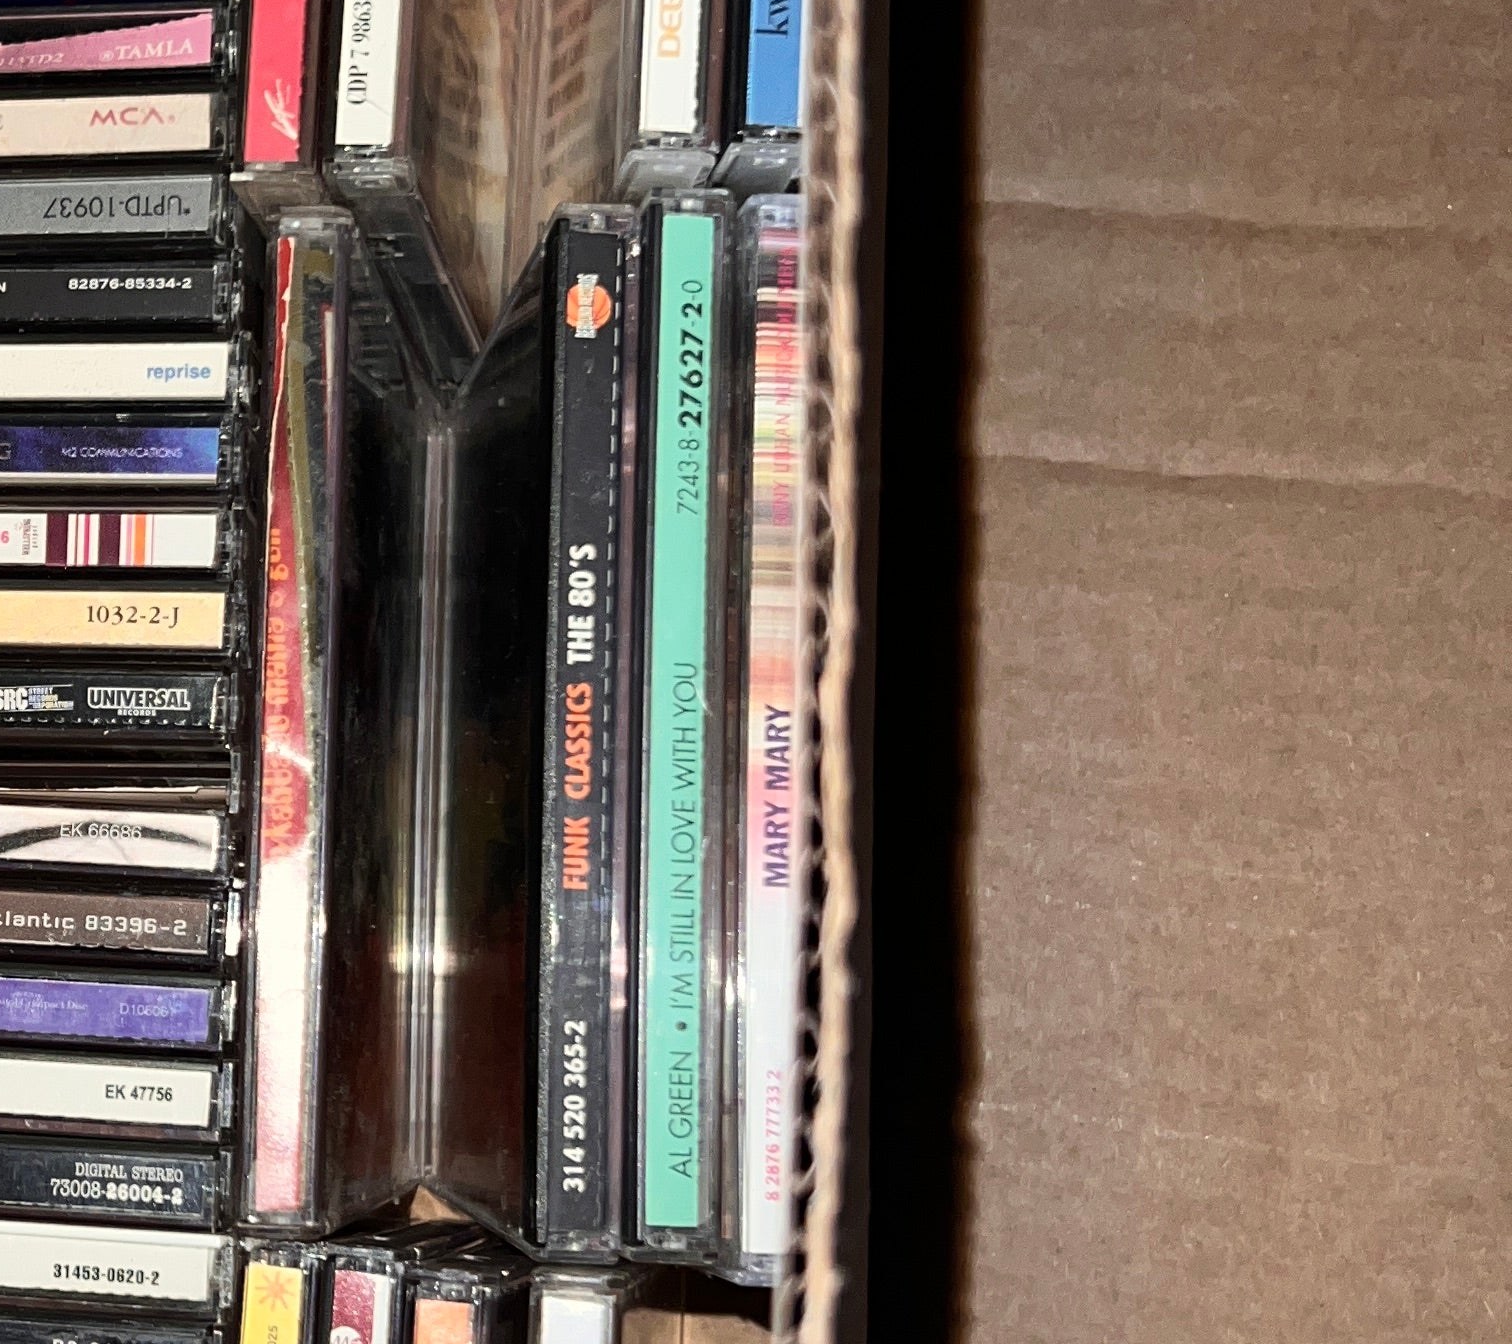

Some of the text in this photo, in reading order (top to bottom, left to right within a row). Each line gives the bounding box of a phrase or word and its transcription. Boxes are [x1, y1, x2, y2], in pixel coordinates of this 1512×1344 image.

[68, 278, 192, 291] 82876-85334-2
[146, 364, 211, 384] reprise
[676, 279, 705, 516] 7243-8-27627-2-0
[87, 605, 180, 628] 1032-2-J
[89, 689, 190, 709] UNIVERSAL
[563, 543, 597, 891] FUNK CLASSICS THE 80'S
[763, 704, 793, 887] MARY MARY
[668, 663, 699, 1180] AL GREEN I'M STILL IN LOVE WITH YOU
[105, 1084, 173, 1102] EK 47756
[53, 1263, 159, 1286] 31453-0620-2
